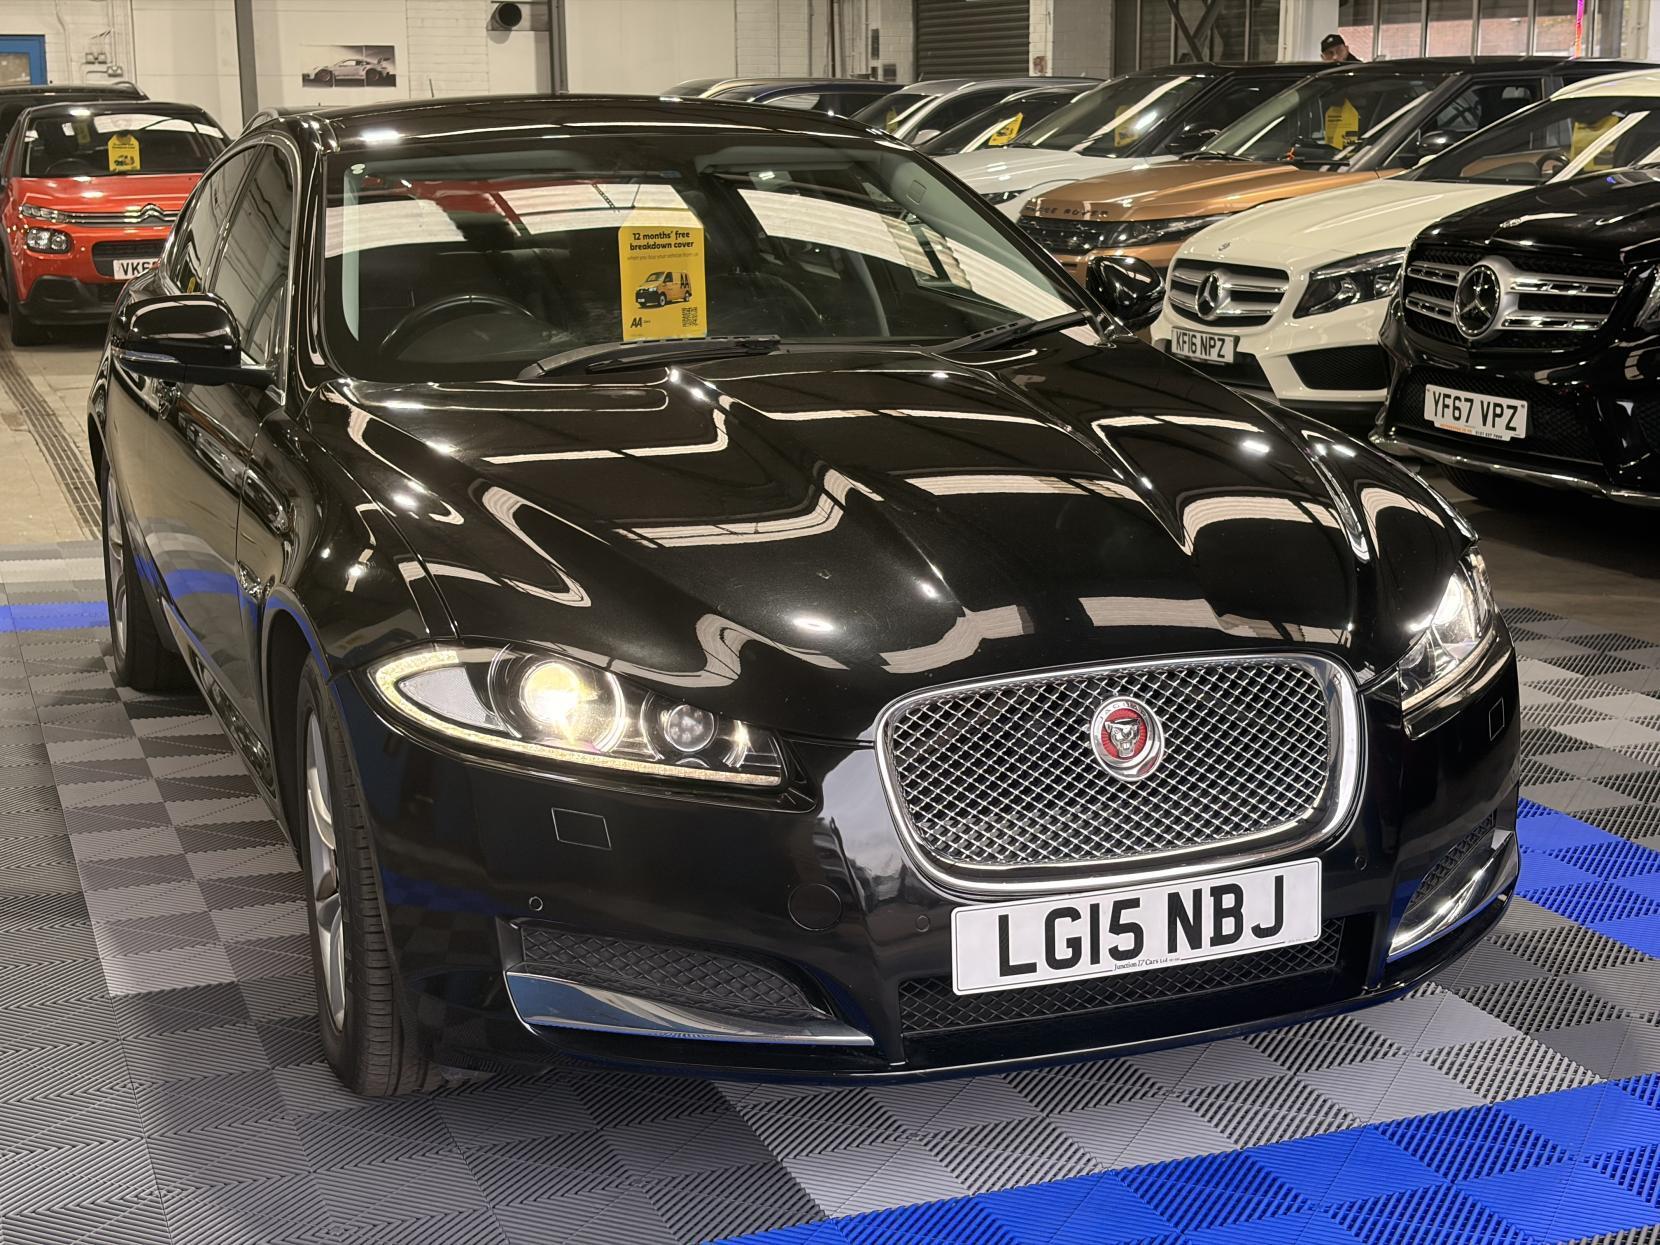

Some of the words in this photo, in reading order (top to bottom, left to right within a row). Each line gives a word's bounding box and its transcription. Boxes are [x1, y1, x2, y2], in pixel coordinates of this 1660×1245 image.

[633, 232, 641, 240] 12
[675, 230, 690, 240] free
[630, 241, 672, 251] breakdown
[673, 241, 694, 249] cover
[121, 261, 156, 276] VK6
[630, 317, 643, 329] AA
[1176, 330, 1197, 354] KF16
[1200, 335, 1226, 359] NPZ
[1432, 390, 1474, 424] YF67
[1480, 400, 1518, 432] VPZ
[998, 897, 1145, 978] LG15
[1167, 875, 1285, 954] NBJ
[1114, 962, 1137, 971] Junction
[1145, 958, 1158, 966] Cars
